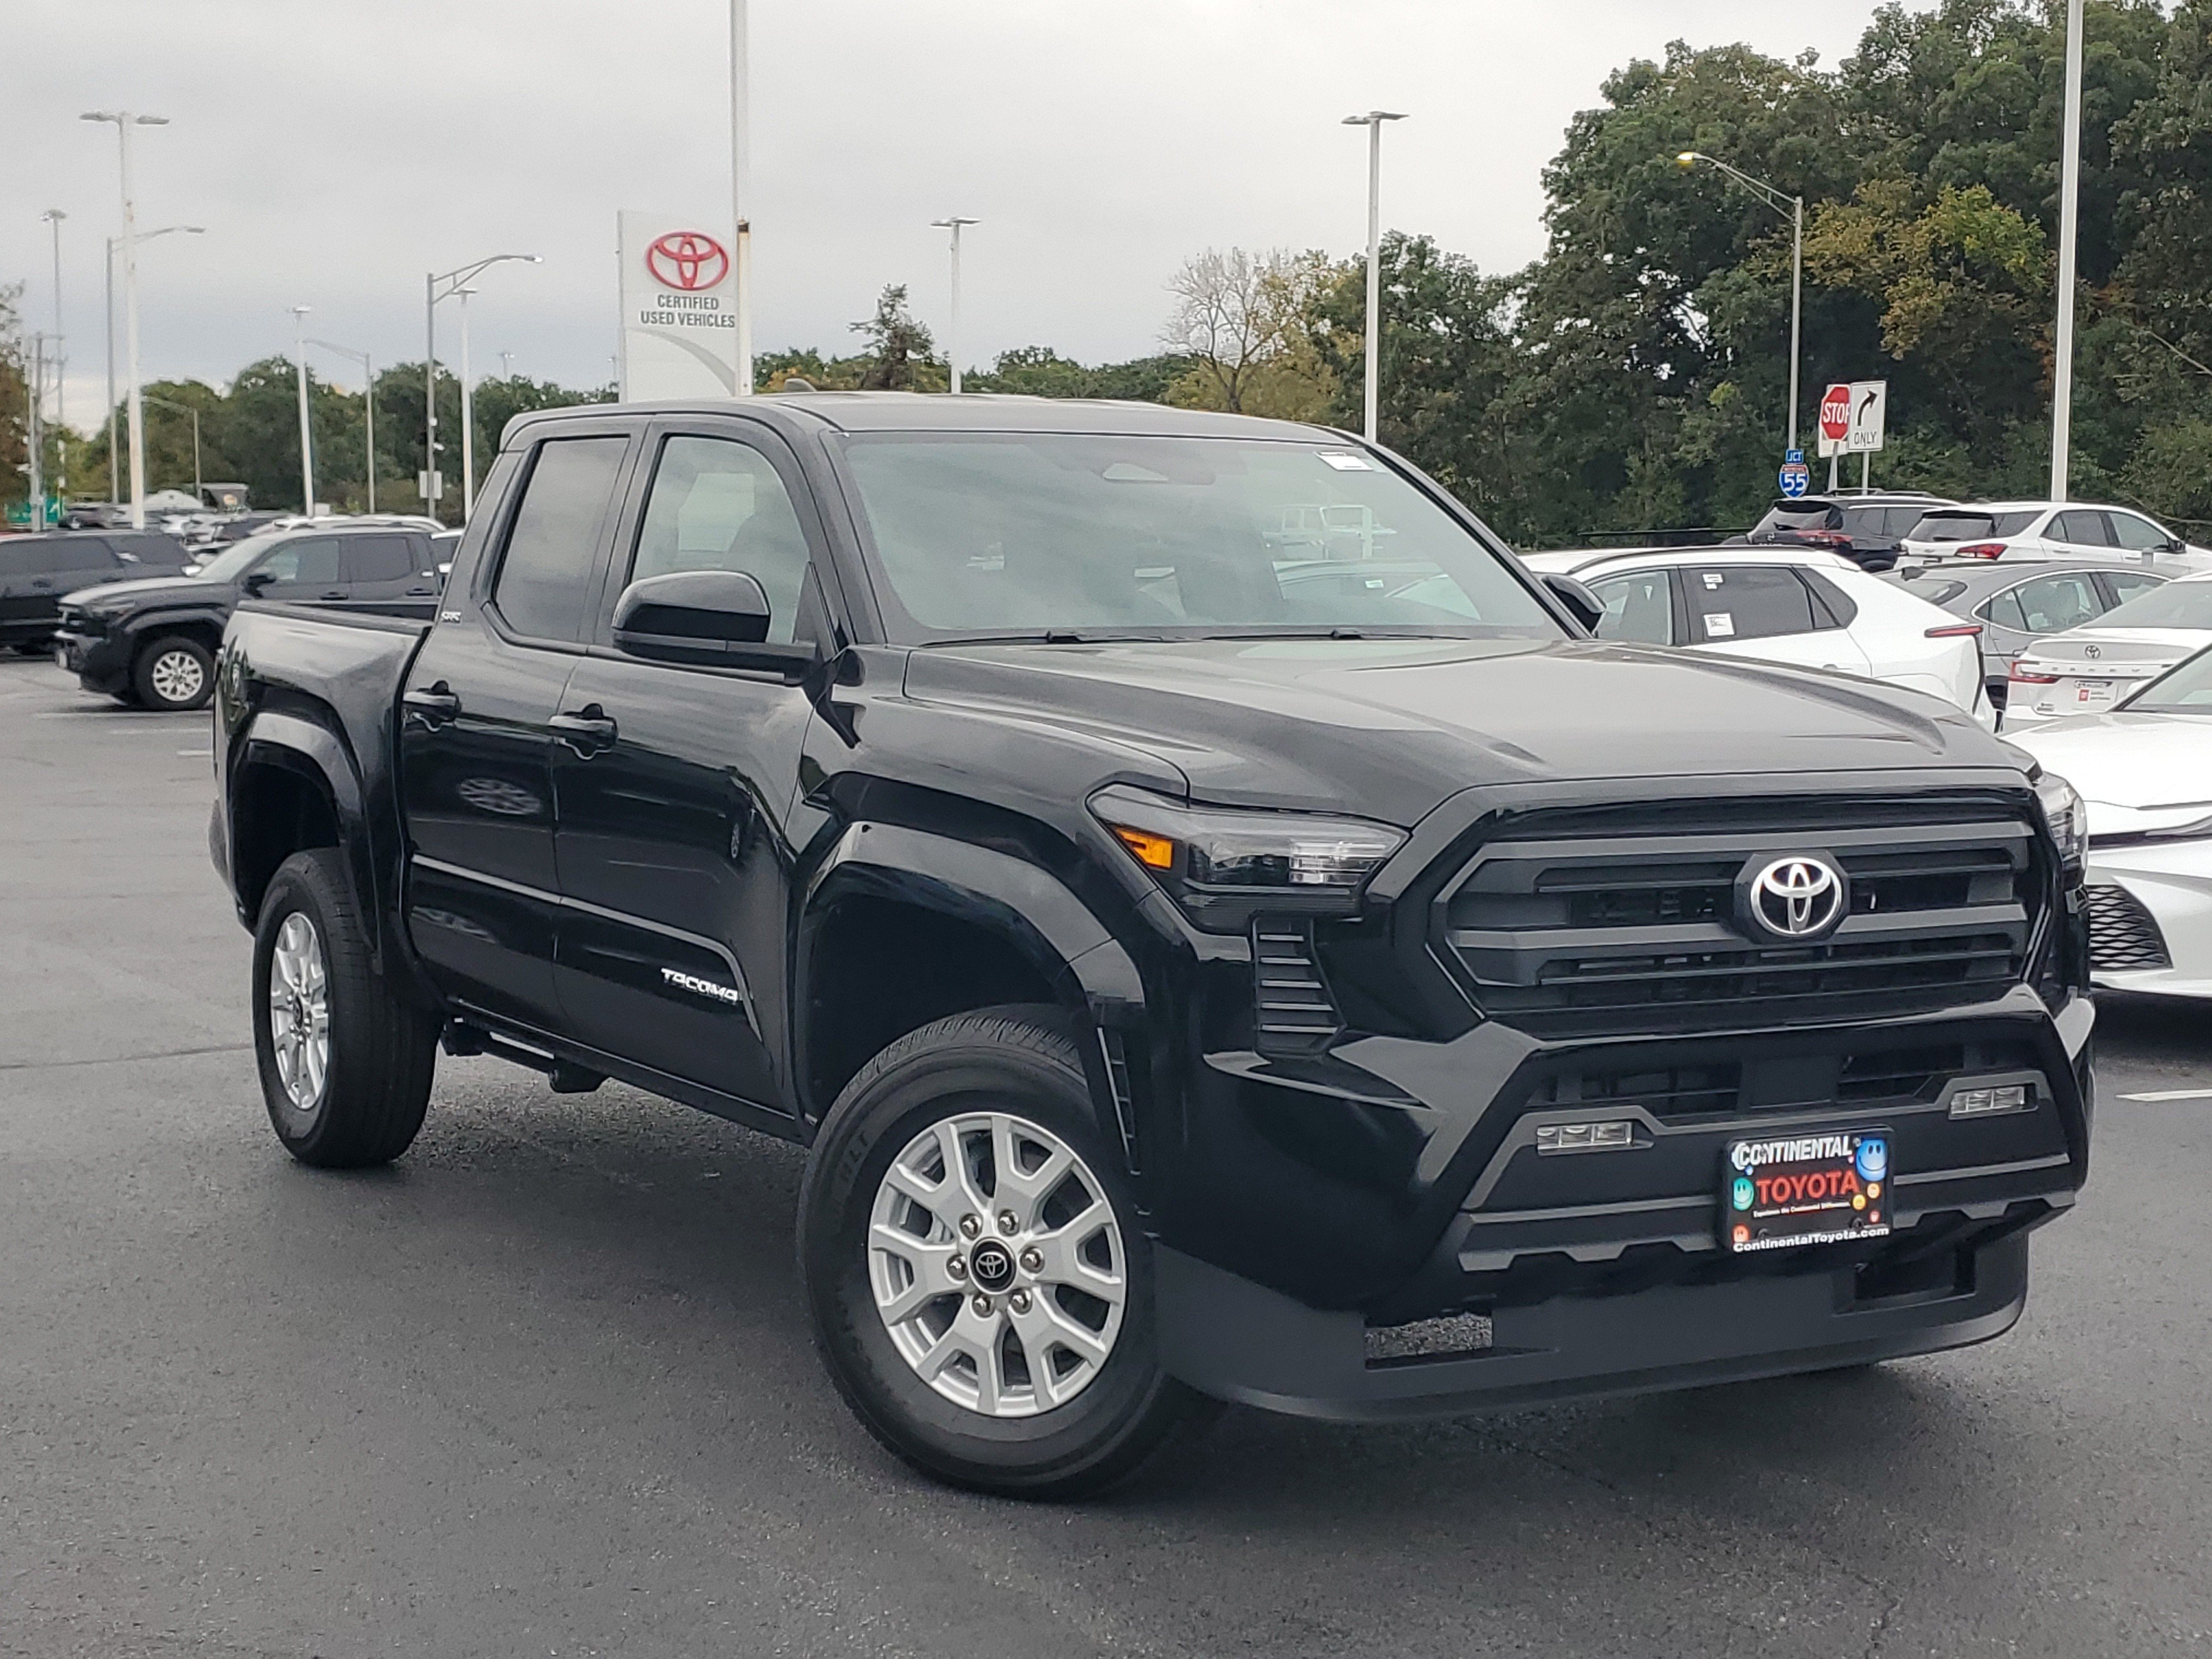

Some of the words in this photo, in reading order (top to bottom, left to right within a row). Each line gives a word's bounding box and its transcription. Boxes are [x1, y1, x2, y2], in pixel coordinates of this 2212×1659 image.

[657, 295, 719, 310] CERTIFIED
[640, 311, 674, 325] USED
[678, 312, 735, 328] VEHICLES
[1854, 431, 1877, 447] ONLY
[1787, 452, 1802, 461] JCT
[1783, 473, 1806, 492] 55
[661, 967, 739, 1002] TACOMA
[1732, 1136, 1853, 1170] CONTINENTAL
[1756, 1169, 1860, 1205] TOYOTA
[1733, 1227, 1889, 1253] ContinentalToyota.com
